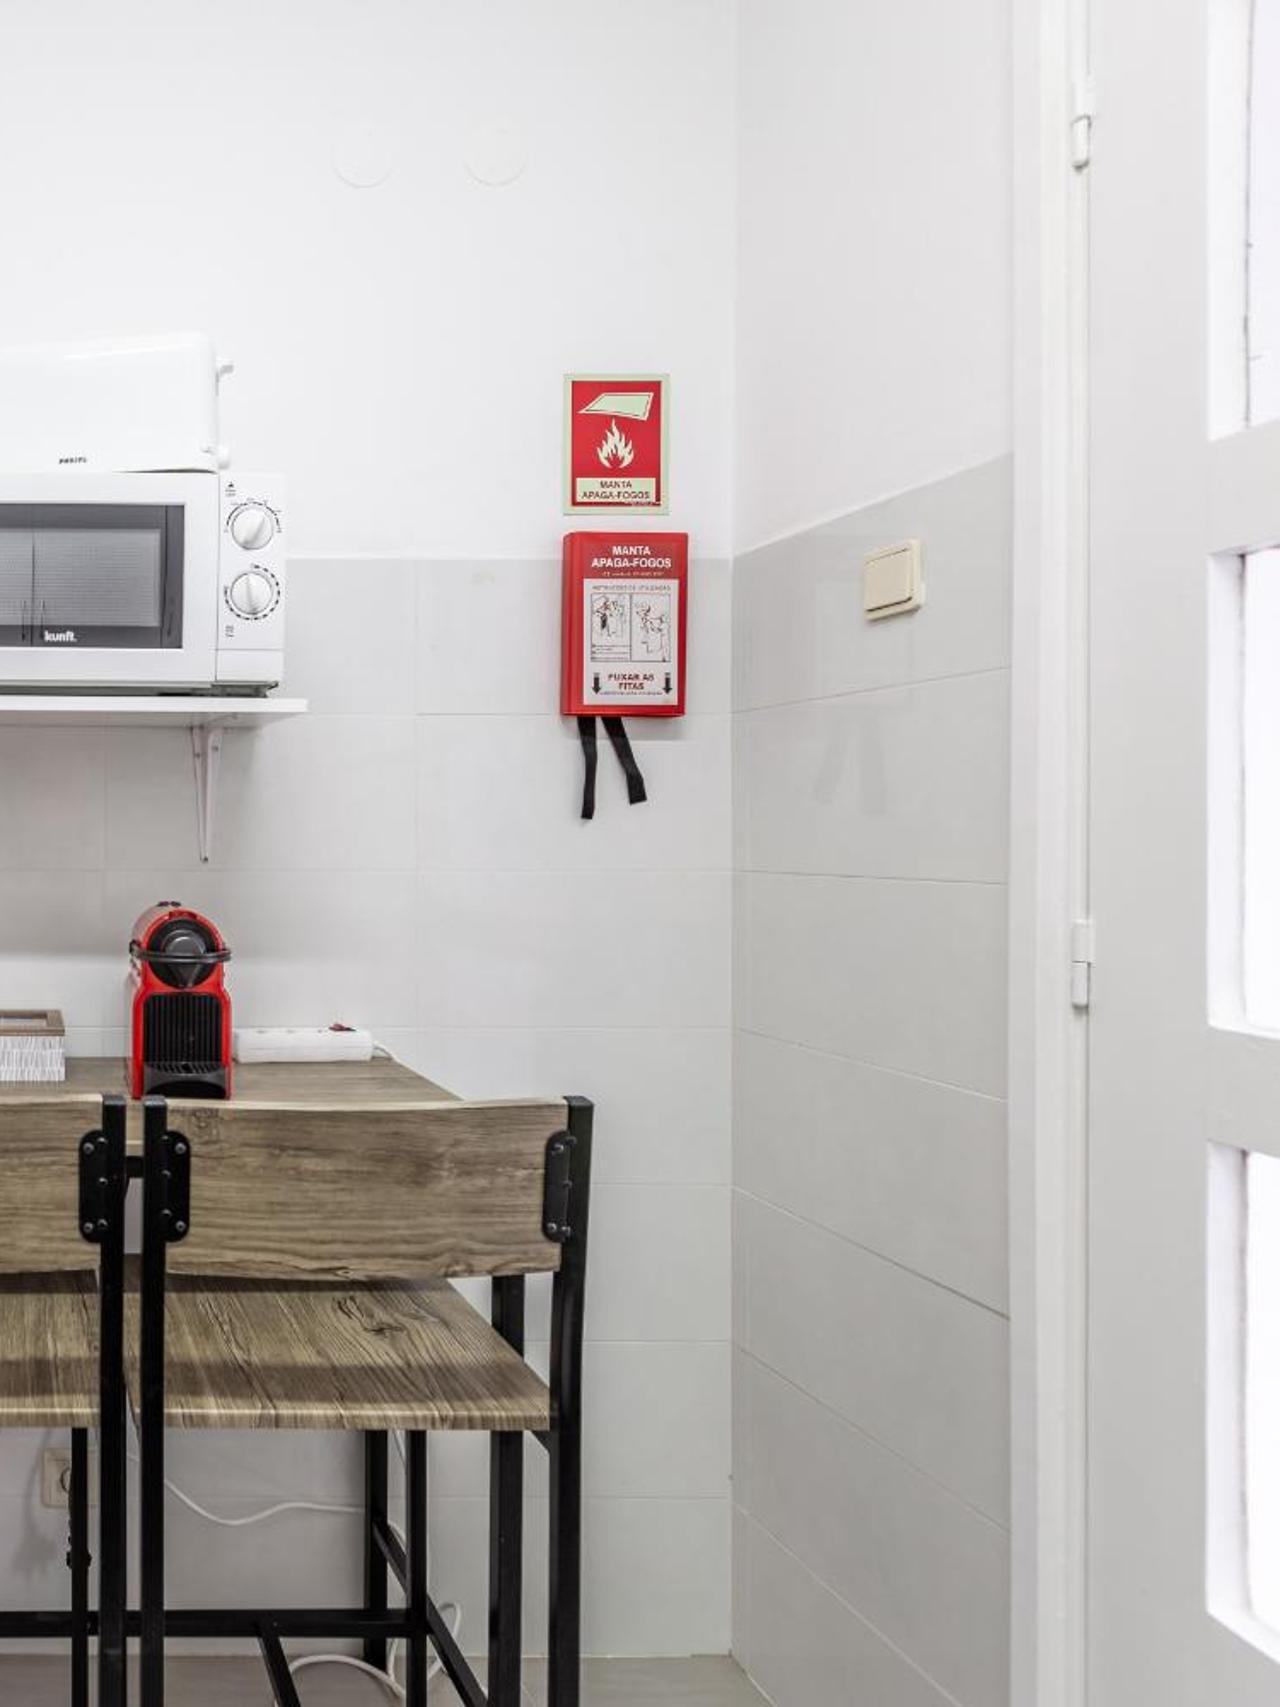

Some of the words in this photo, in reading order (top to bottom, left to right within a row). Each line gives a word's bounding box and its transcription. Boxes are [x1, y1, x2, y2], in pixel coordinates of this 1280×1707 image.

[600, 480, 633, 489] MANTA
[581, 491, 651, 500] APAGA-FOGOS
[612, 545, 651, 555] MANTA
[591, 558, 672, 568] APAGA-FOGOS
